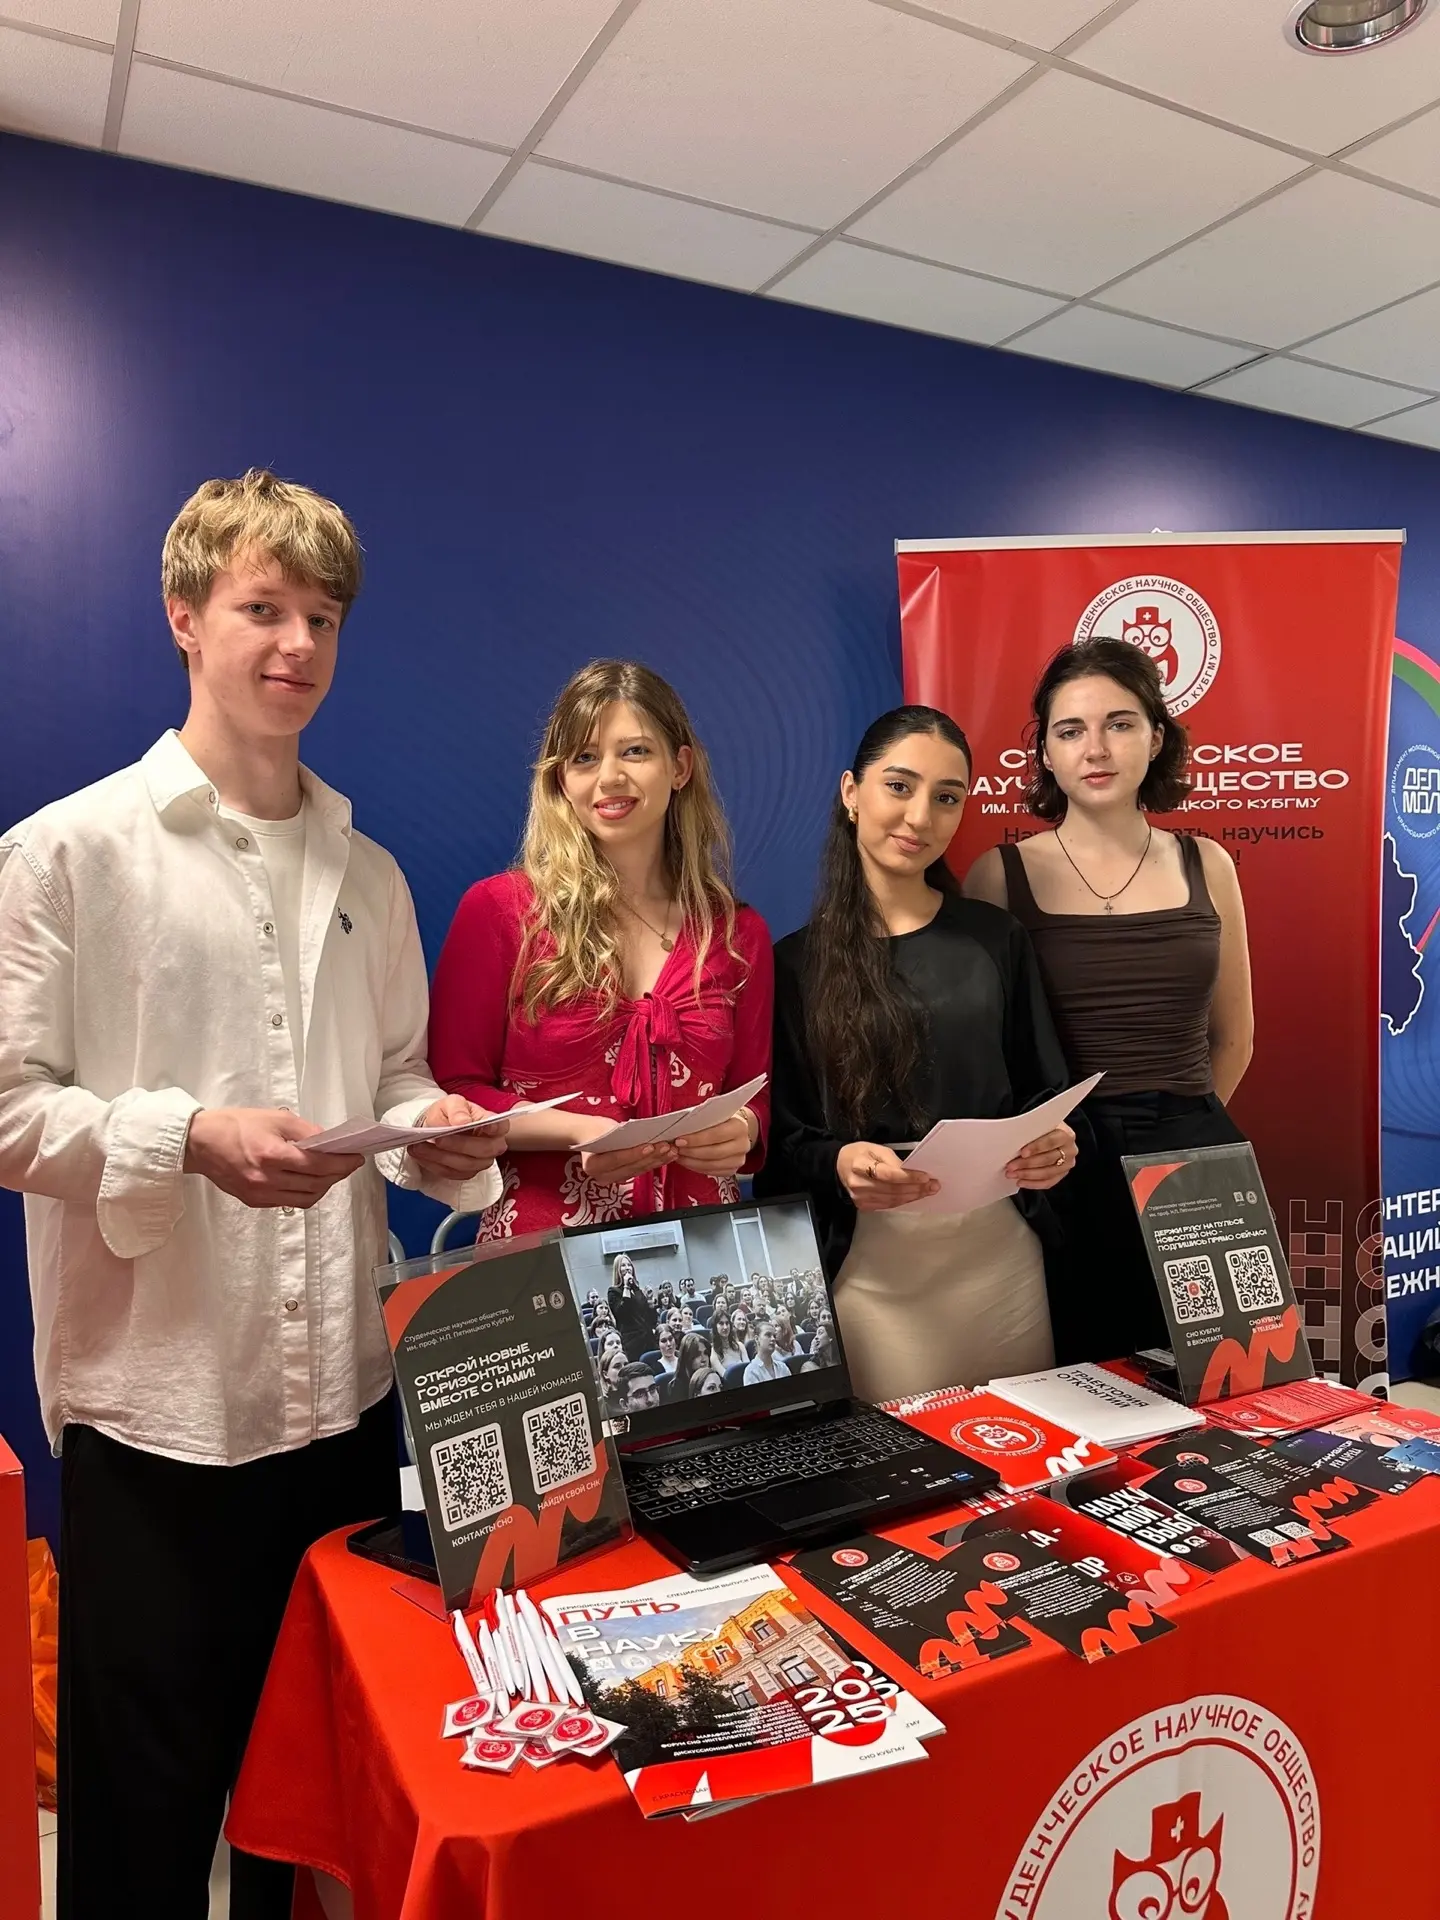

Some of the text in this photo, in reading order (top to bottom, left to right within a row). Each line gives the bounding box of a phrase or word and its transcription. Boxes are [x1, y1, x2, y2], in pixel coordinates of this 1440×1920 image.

[1076, 578, 1218, 647] ТУДЕНЧЕСКОЕ НАУЧНОЕ ОБЩЕСТВО
[1191, 653, 1218, 699] КУБГМУ
[981, 803, 1010, 814] ИМ.
[1247, 797, 1321, 810] КУБГМУ
[1222, 825, 1325, 845] научись
[1154, 1226, 1182, 1238] ДЕРЖИ
[1182, 1224, 1201, 1233] РУКУ
[1203, 1222, 1214, 1230] НА
[1157, 1238, 1208, 1252] ПОДПИШИСЬ
[1199, 1229, 1218, 1237] СНО
[404, 1308, 510, 1343] Студенческое научное общество
[418, 1337, 439, 1350] проф.
[453, 1322, 491, 1339] Пятницкого
[491, 1314, 516, 1328] КубГМУ
[1185, 1330, 1198, 1339] СНО
[1192, 1333, 1225, 1346] ВКОНТАКТЕ
[414, 1342, 530, 1387] ОТКРОЙ НОВЫЕ
[417, 1347, 555, 1400] ГОРИЗОНТЫ НАУКИ
[419, 1366, 537, 1414] ВМЕСТЕ С НАМИ!
[424, 1370, 585, 1433] МЫ ЖДЕМ ТЕБЯ В НАШЕЙ КОМАНДЕ!
[1056, 1372, 1131, 1409] ОТКРЫТИЙ
[1070, 1369, 1150, 1409] ТРАЕКТОРИЯ
[537, 1494, 565, 1511] НАЙДИ
[565, 1483, 585, 1500] СВОЙ
[451, 1515, 514, 1548] КОНТАКТЫ СНО
[1105, 1503, 1165, 1531] МОЙ
[559, 1602, 680, 1625] ПУТЬ
[566, 1624, 602, 1642] В
[578, 1624, 724, 1659] НАУКУ
[794, 1678, 871, 1713] 20
[810, 1698, 892, 1736] 25
[859, 1745, 905, 1761] СНО КУБГМУ
[659, 1786, 709, 1800] КРАСНОДАР
[1153, 1703, 1263, 1743] НАУЧНОЕ
[1262, 1728, 1316, 1869] ОБЩЕСТВО
